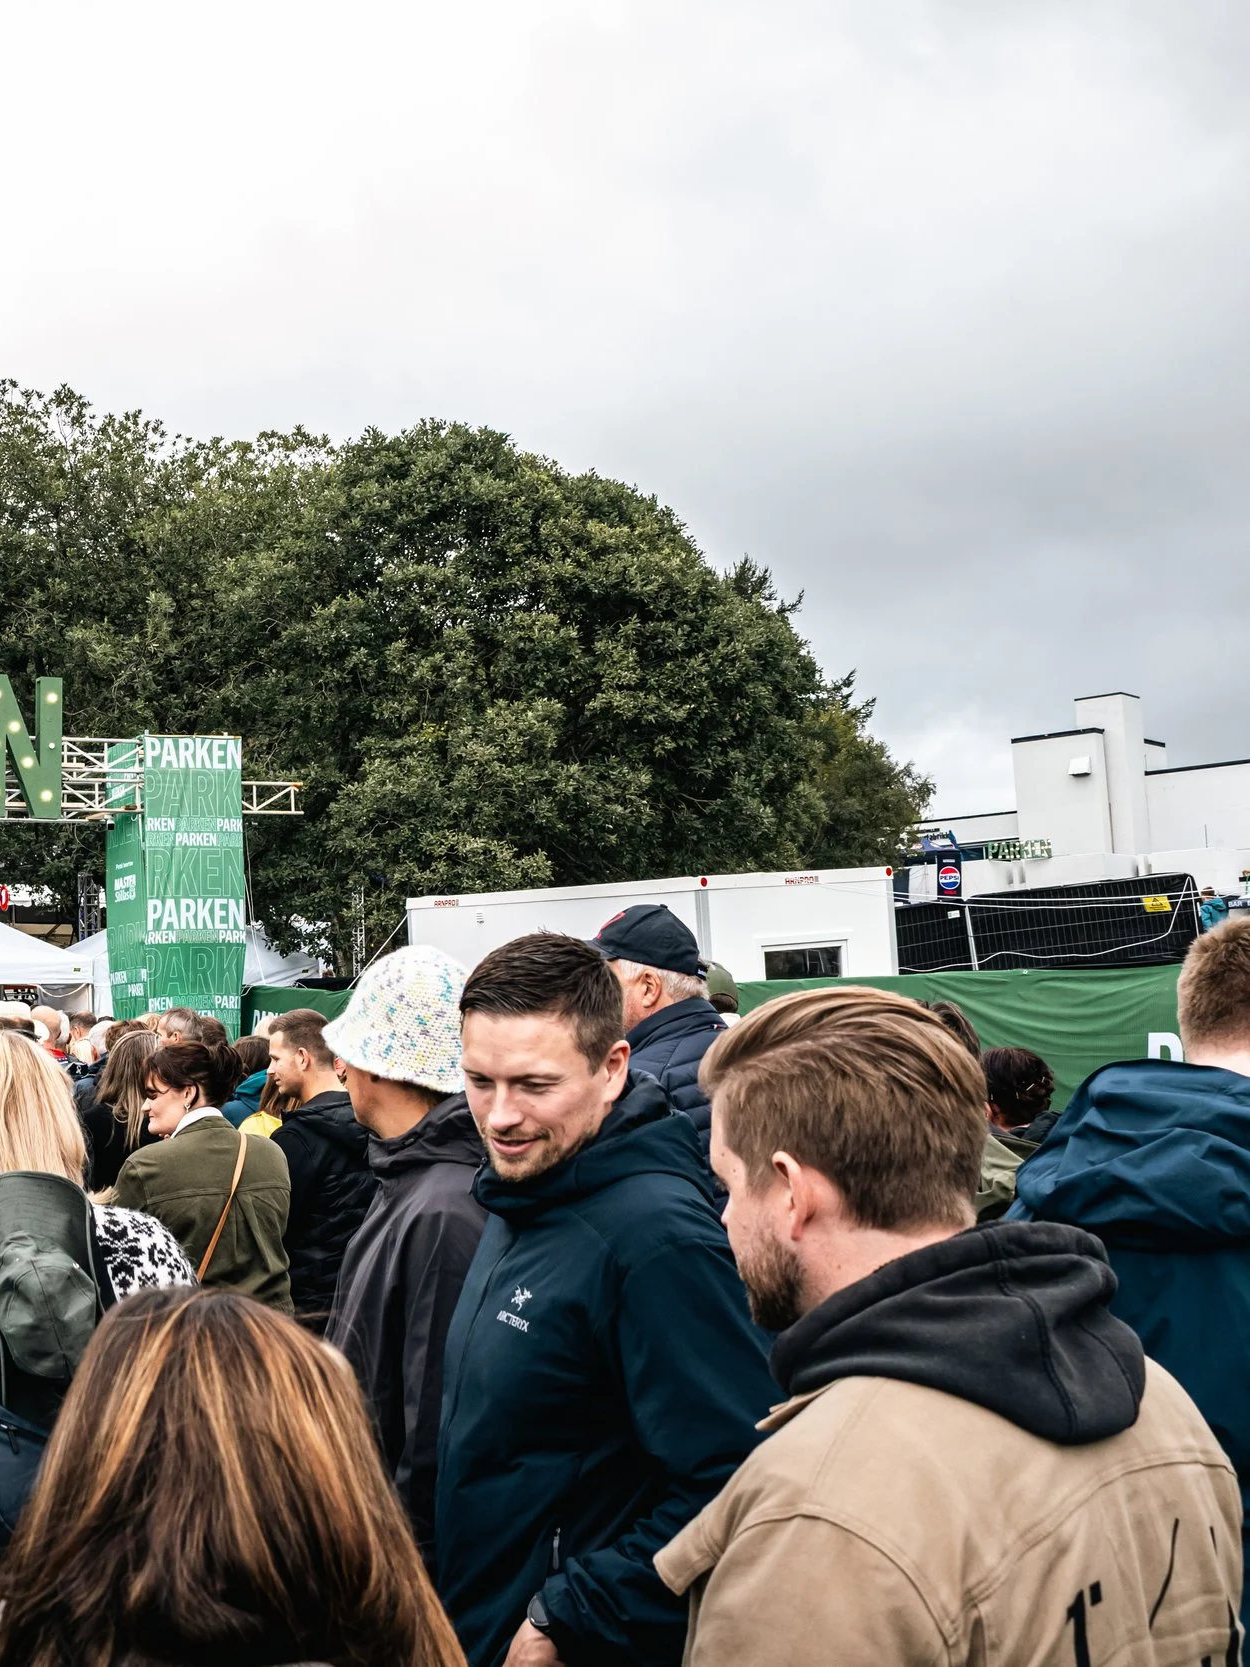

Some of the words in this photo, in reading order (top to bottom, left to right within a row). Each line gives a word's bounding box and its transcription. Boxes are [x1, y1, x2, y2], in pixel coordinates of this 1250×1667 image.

[145, 737, 242, 769] PARKEN
[175, 832, 217, 847] PARKEN
[987, 839, 1053, 860] PARKEN
[147, 898, 245, 930] PARKEN
[1228, 900, 1243, 908] BAR
